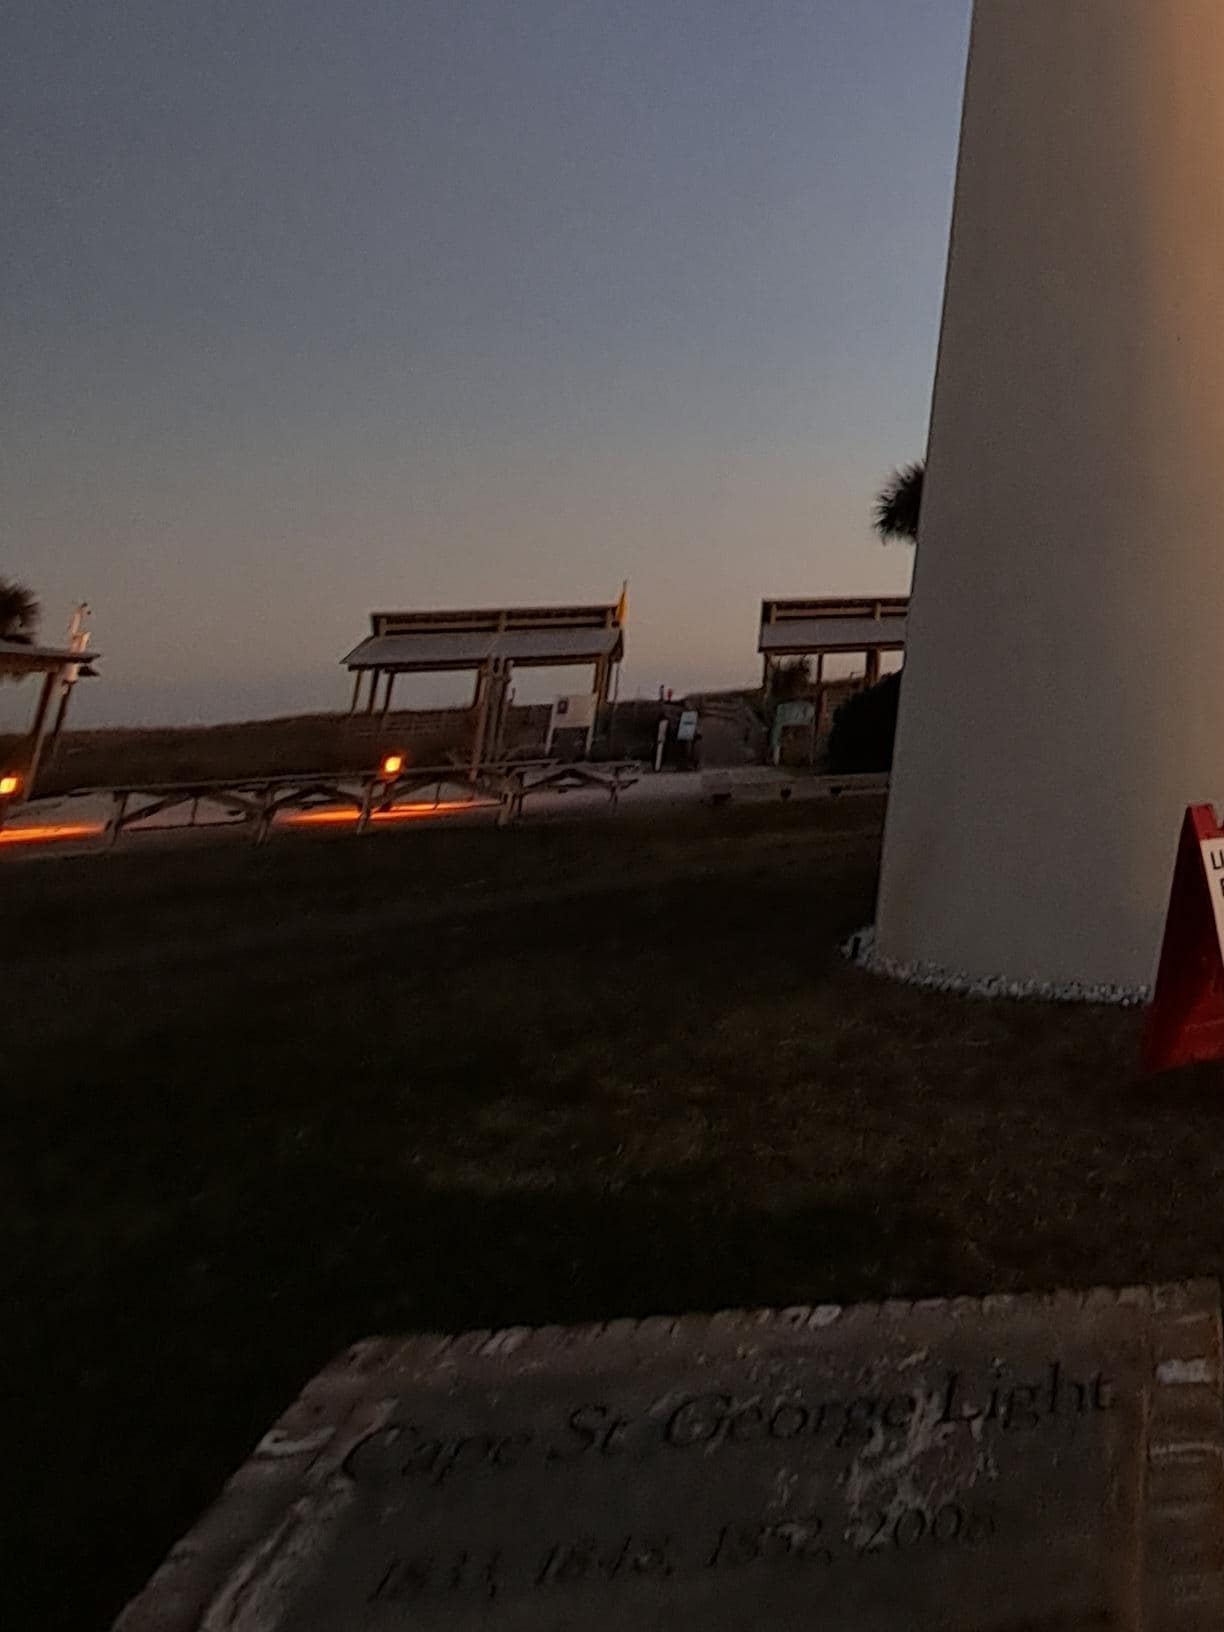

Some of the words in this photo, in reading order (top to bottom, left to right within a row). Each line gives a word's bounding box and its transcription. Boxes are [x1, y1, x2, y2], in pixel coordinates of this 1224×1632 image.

[342, 1421, 532, 1488] Cape
[663, 1390, 917, 1448] George
[936, 1360, 1117, 1432] Light
